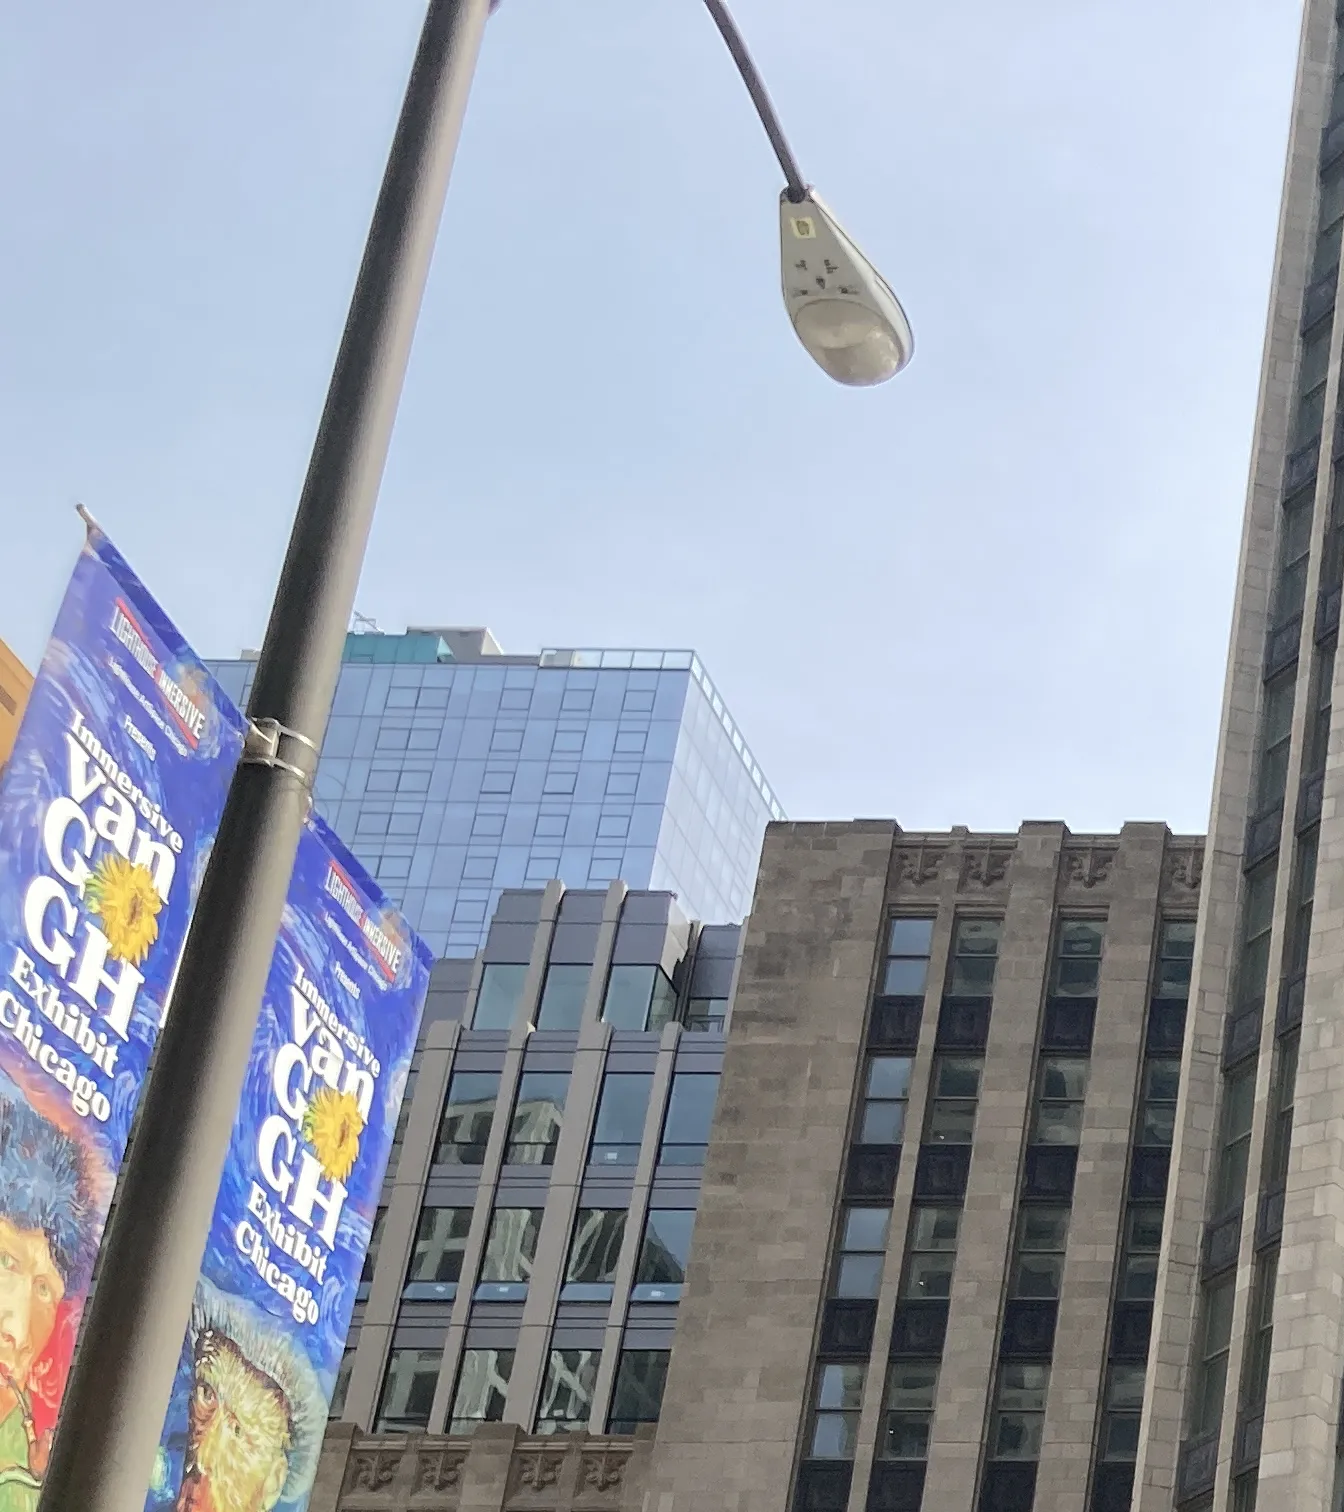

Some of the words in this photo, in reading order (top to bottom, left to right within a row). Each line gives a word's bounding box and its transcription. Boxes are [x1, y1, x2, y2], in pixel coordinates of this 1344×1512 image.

[158, 669, 206, 740] IMMERSIVE
[71, 709, 184, 854] Immersive
[0, 990, 111, 1122] Chicago
[9, 947, 119, 1078] Exhibit
[293, 963, 381, 1079] Immersive
[235, 1221, 319, 1325] Chicago
[248, 1180, 329, 1285] Exhibit
